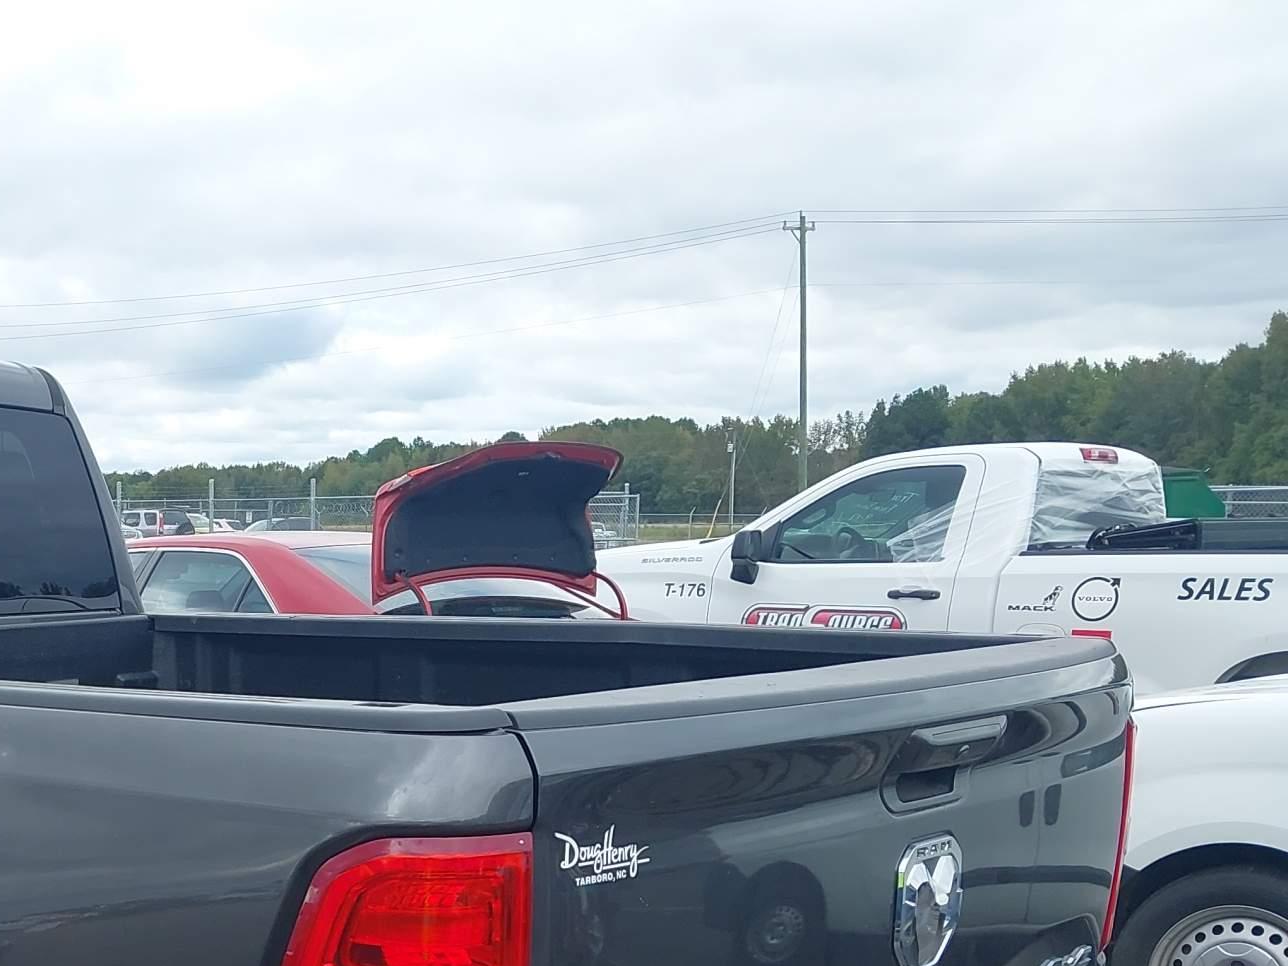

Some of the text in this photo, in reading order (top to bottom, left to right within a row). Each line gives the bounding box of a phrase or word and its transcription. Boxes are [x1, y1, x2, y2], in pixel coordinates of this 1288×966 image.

[640, 556, 704, 564] SILVERADO
[664, 583, 706, 598] T-176
[1177, 577, 1274, 602] SALES
[1007, 604, 1056, 612] MACK
[916, 839, 953, 858] RAM
[575, 869, 627, 887] TARBORO, NC
